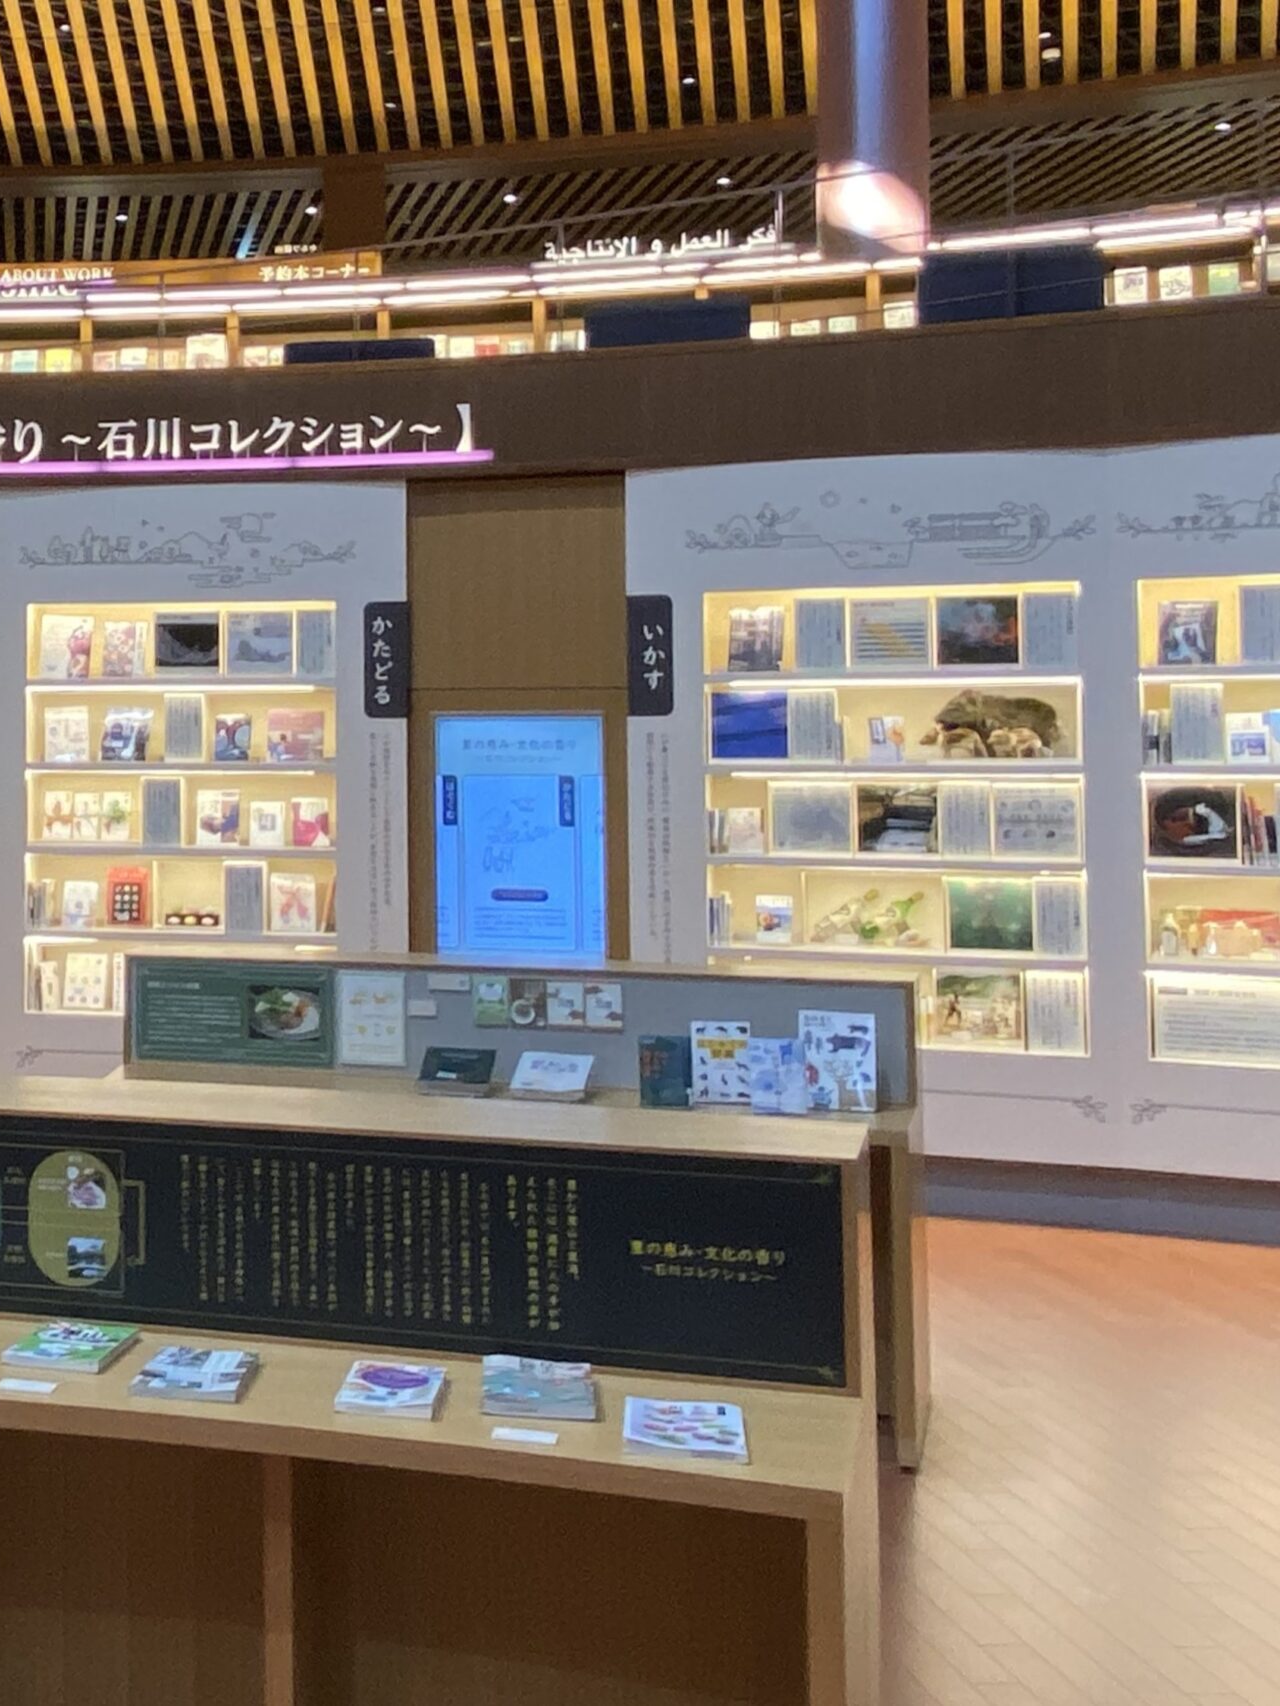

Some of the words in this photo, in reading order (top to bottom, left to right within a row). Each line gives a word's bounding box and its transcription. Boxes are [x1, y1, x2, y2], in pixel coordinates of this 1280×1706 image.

[1, 267, 60, 283] ABOUT
[62, 265, 115, 282] WORK
[370, 616, 394, 705] かたどる
[642, 623, 666, 690] いかす
